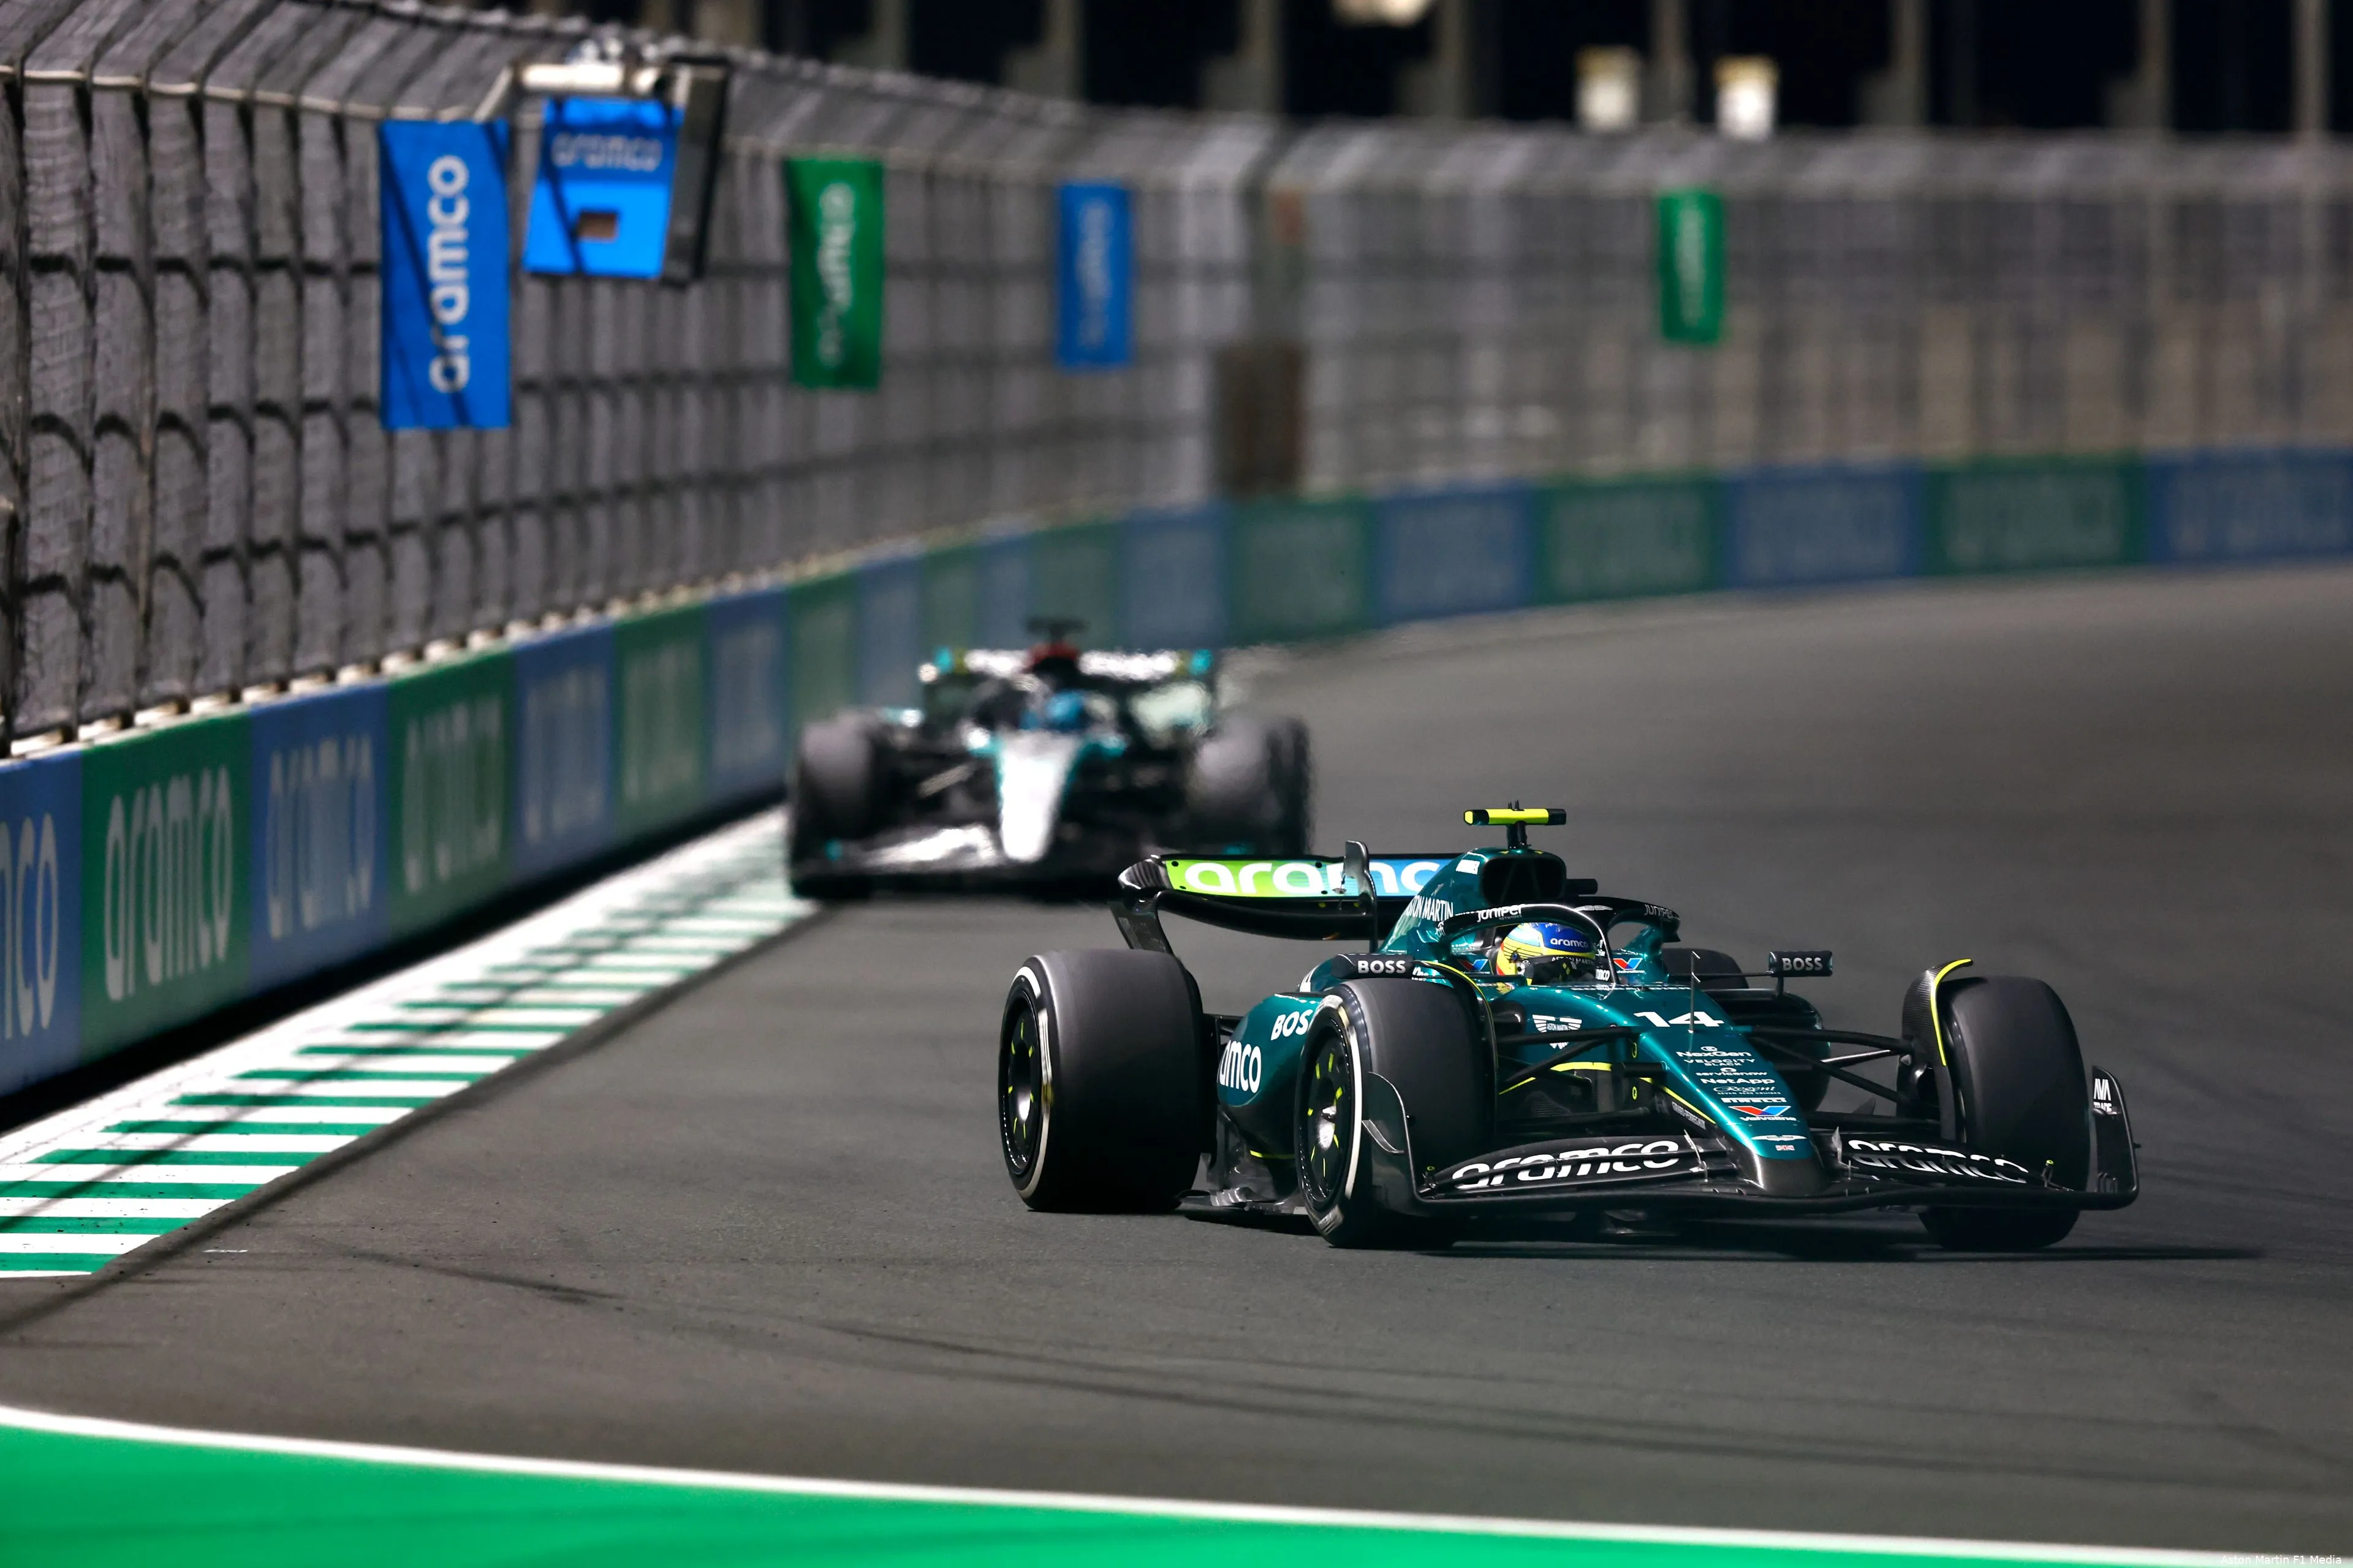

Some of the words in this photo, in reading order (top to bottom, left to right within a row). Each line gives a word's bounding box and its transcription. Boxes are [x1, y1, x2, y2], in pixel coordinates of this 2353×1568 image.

[428, 156, 469, 394] aramco
[104, 766, 233, 1001] aramco
[1184, 862, 1440, 894] aramc
[1422, 896, 1453, 922] MARTIN
[1550, 934, 1588, 947] aramco
[1357, 960, 1406, 974] BOSS
[1782, 957, 1823, 971] BOSS
[1270, 1009, 1314, 1040] BOS
[1633, 1011, 1725, 1028] 14
[1452, 1140, 1680, 1190] aramco
